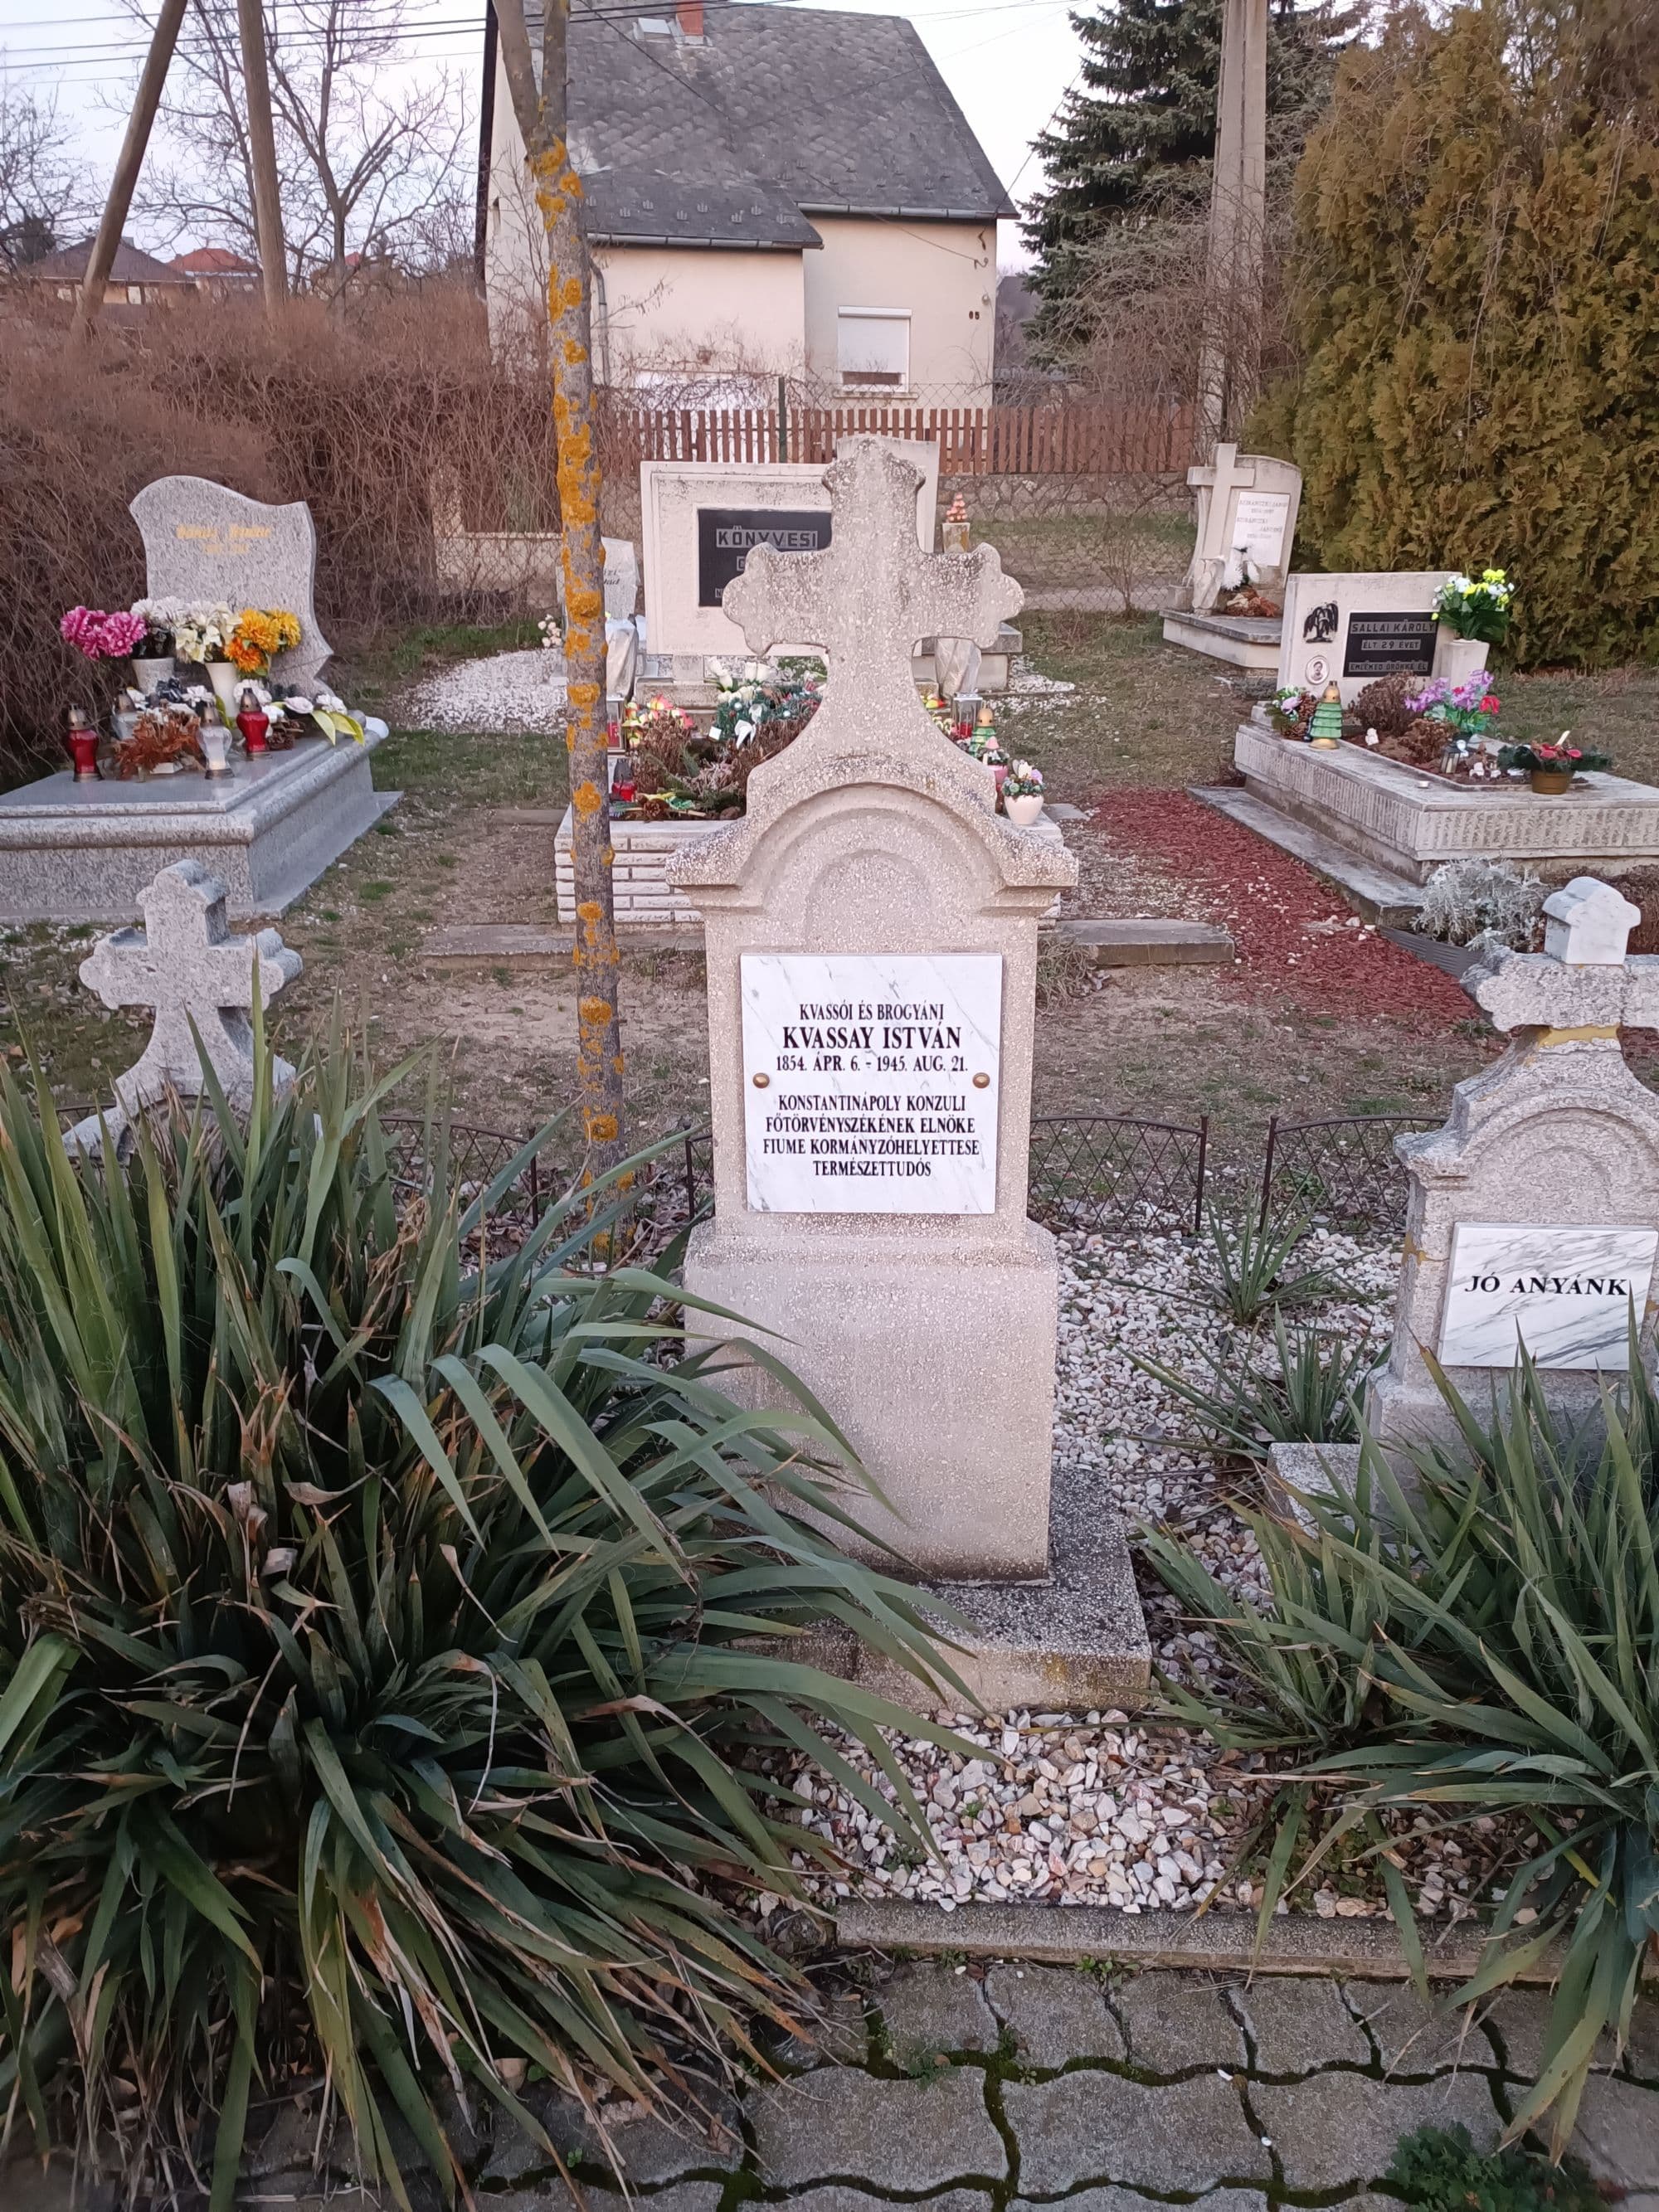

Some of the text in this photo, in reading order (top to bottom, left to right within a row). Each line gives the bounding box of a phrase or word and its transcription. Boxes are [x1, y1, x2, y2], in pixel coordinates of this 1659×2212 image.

[718, 525, 816, 547] KÖNYVESI
[1351, 619, 1435, 633] SALLAI KÁROLY
[1381, 640, 1395, 649] 29
[800, 999, 944, 1021] KVASSÓI ÉS BROGYÁNI
[782, 1021, 962, 1049] KVASSAY ISTVÁN
[776, 1054, 808, 1072] 1854.
[813, 1051, 846, 1072] ÁPR.
[850, 1054, 861, 1072] 6.
[877, 1055, 907, 1072] 1945.
[913, 1055, 946, 1072] AUG.
[951, 1055, 969, 1072] 21.
[778, 1091, 966, 1111] KONSTANTINÁPOLY KONZULI
[766, 1112, 975, 1134] FŐTÖRVÉNYSZÉKÉNEK ELNÖKE
[762, 1135, 980, 1155] FIUME KORMÁNYZÓHELYETTESE
[812, 1157, 932, 1177] TERMÉSZETTUDÓS
[1464, 1271, 1627, 1296] JÓ ANYÁNK
